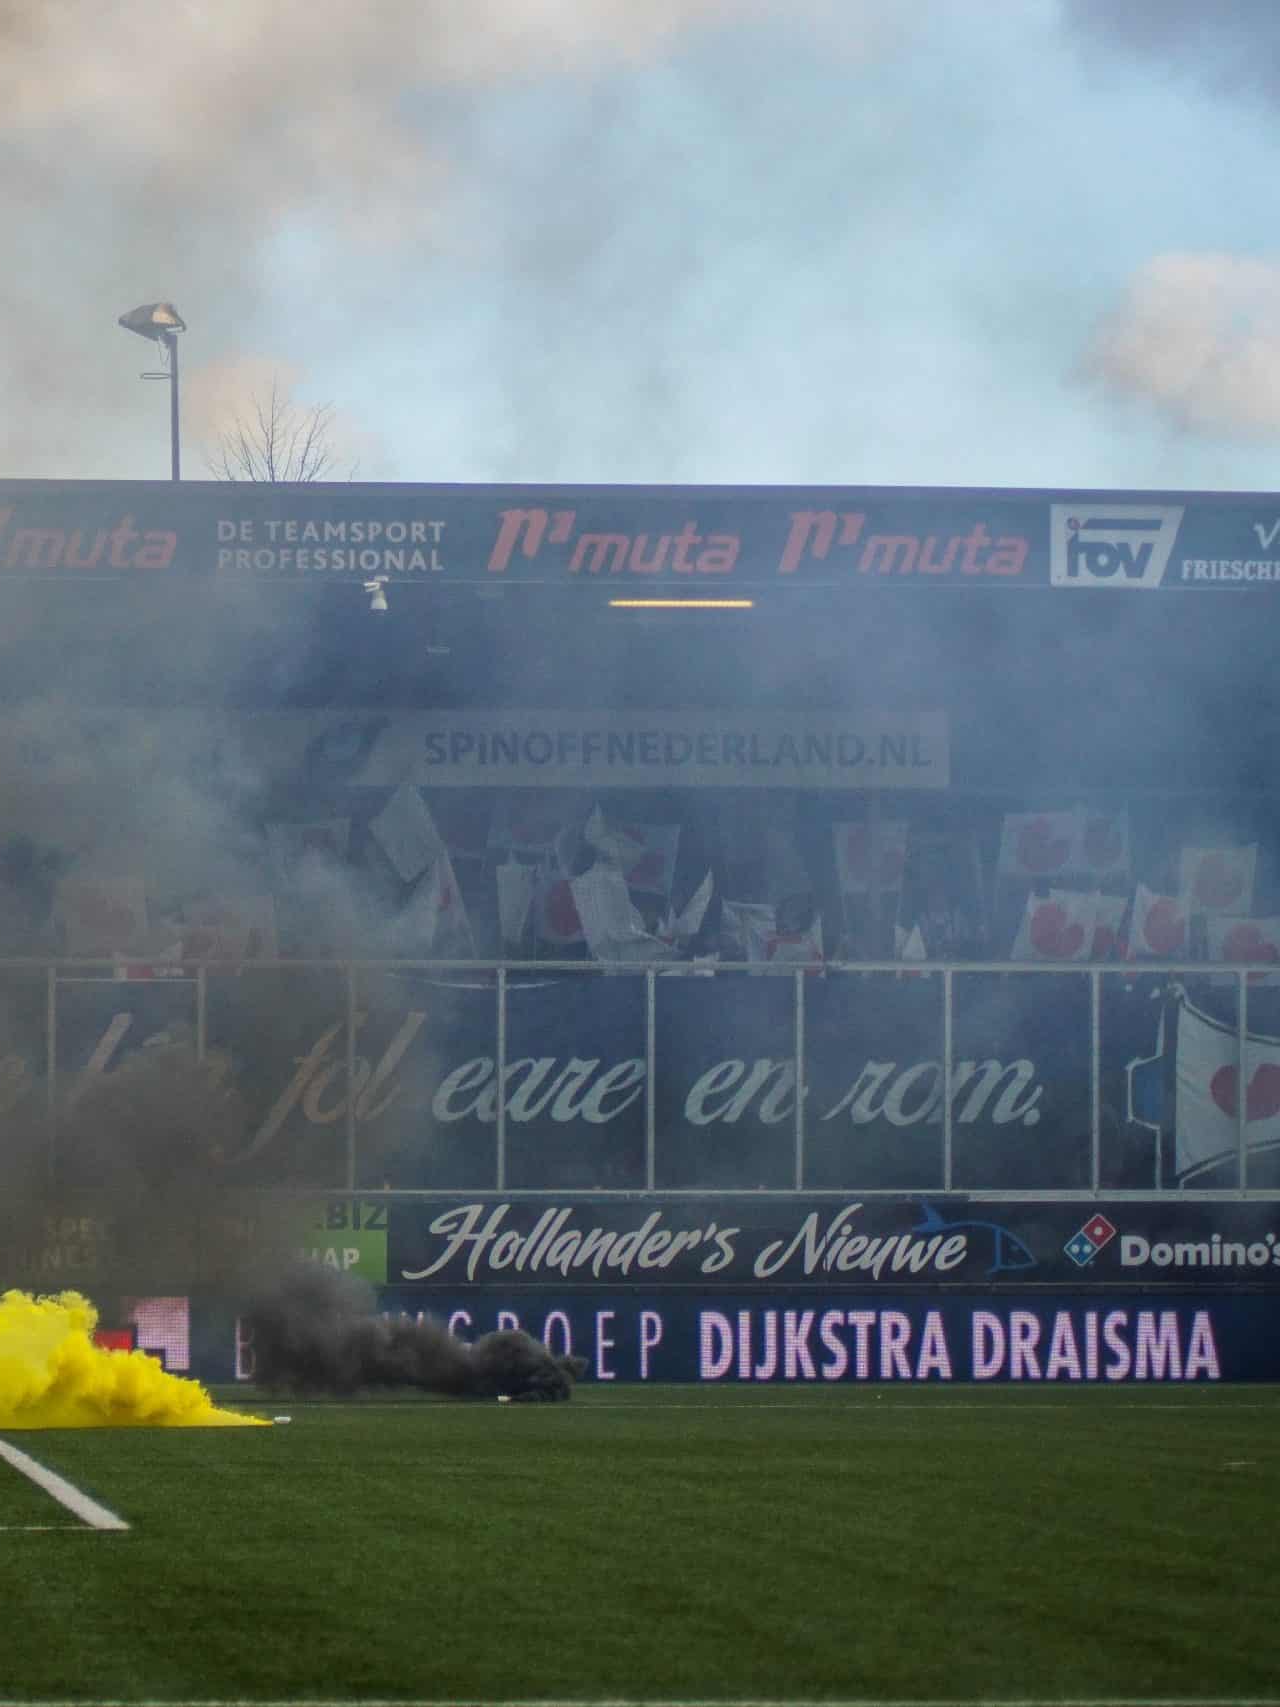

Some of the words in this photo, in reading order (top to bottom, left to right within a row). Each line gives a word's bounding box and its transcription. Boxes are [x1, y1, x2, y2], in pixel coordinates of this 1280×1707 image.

[3, 513, 178, 569] muta
[217, 519, 255, 543] DE
[264, 520, 447, 546] TEAMSPORT
[217, 546, 445, 573] PROFESSIONAL
[567, 520, 742, 575] muta
[857, 520, 1031, 578] muta
[431, 1056, 648, 1124] eare
[684, 1056, 805, 1125] en
[403, 1204, 738, 1281] Hollander's
[754, 1205, 968, 1280] Nieuwe
[699, 1311, 952, 1382] DIJKSTRA
[972, 1311, 1221, 1382] DRAISMA
